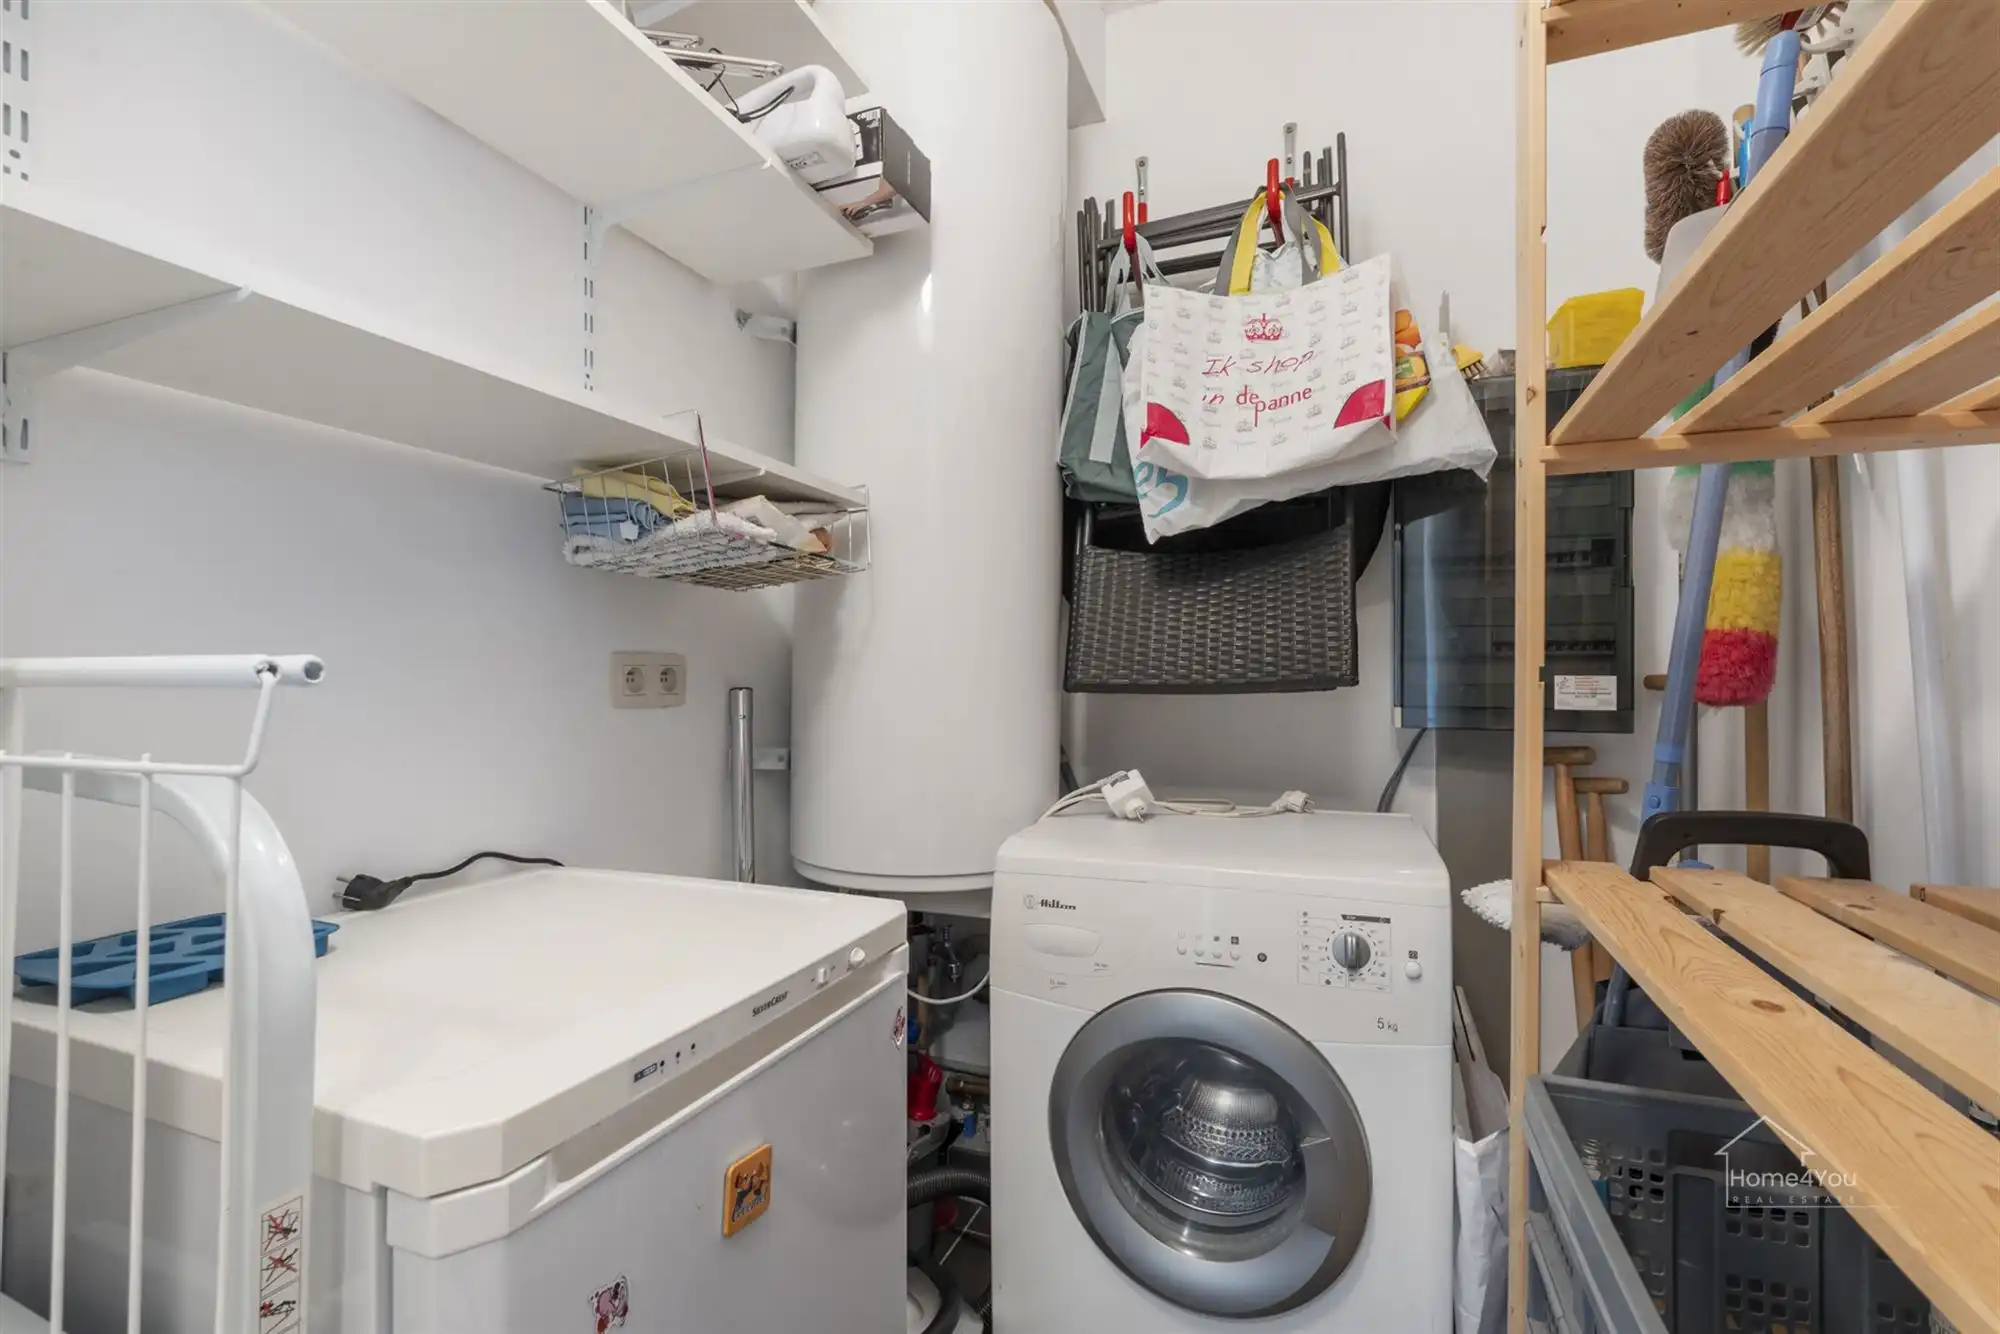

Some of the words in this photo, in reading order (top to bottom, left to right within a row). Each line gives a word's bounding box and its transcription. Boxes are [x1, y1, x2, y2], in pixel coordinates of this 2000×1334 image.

[1201, 355, 1237, 377] Ik
[1246, 350, 1315, 375] shop
[1377, 1018, 1385, 1030] 5
[1387, 1021, 1399, 1033] kg
